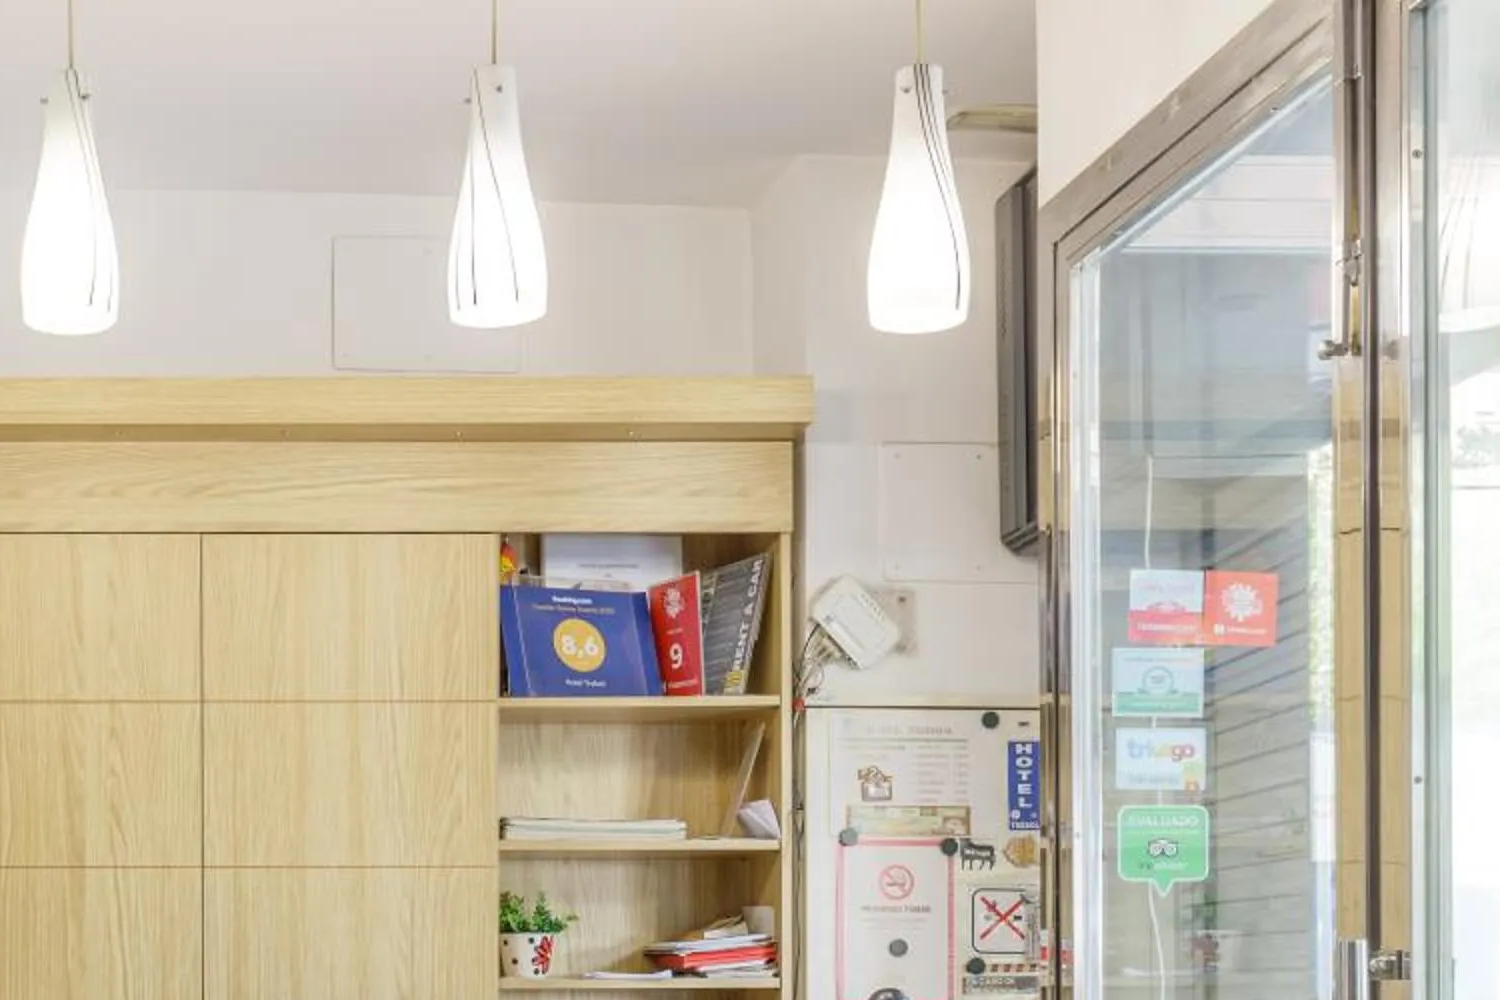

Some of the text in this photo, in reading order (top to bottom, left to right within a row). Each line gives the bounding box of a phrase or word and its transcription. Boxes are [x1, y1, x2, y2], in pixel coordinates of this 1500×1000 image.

[669, 642, 684, 670] 9
[732, 620, 750, 672] RENT
[743, 602, 755, 616] A
[1015, 743, 1033, 809] HOTEL
